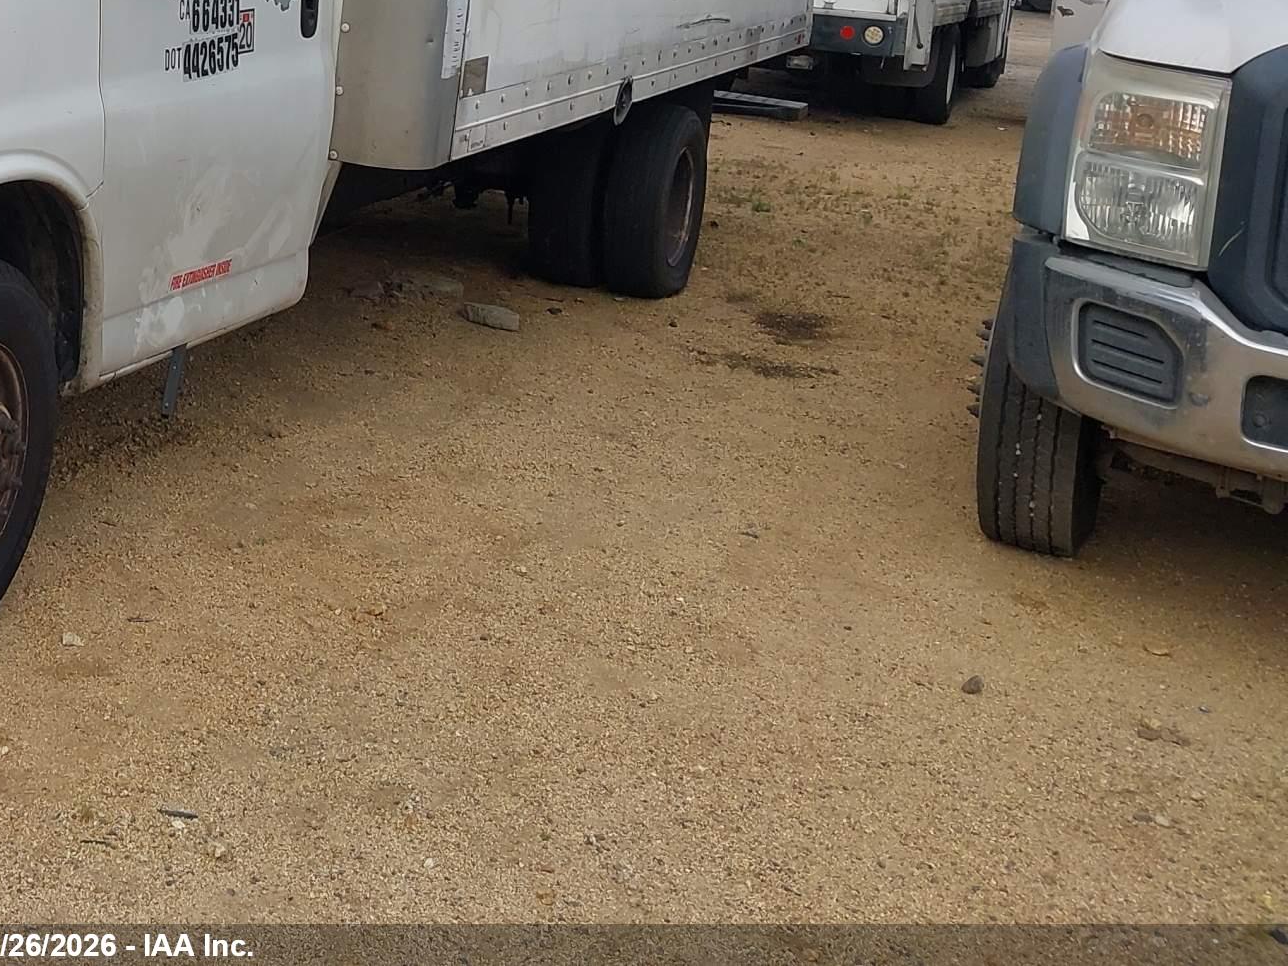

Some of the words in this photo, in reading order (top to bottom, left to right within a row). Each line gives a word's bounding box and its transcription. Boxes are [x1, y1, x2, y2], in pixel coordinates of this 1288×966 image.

[239, 21, 253, 50] 20
[165, 47, 182, 71] DOT
[183, 32, 239, 80] 4426575
